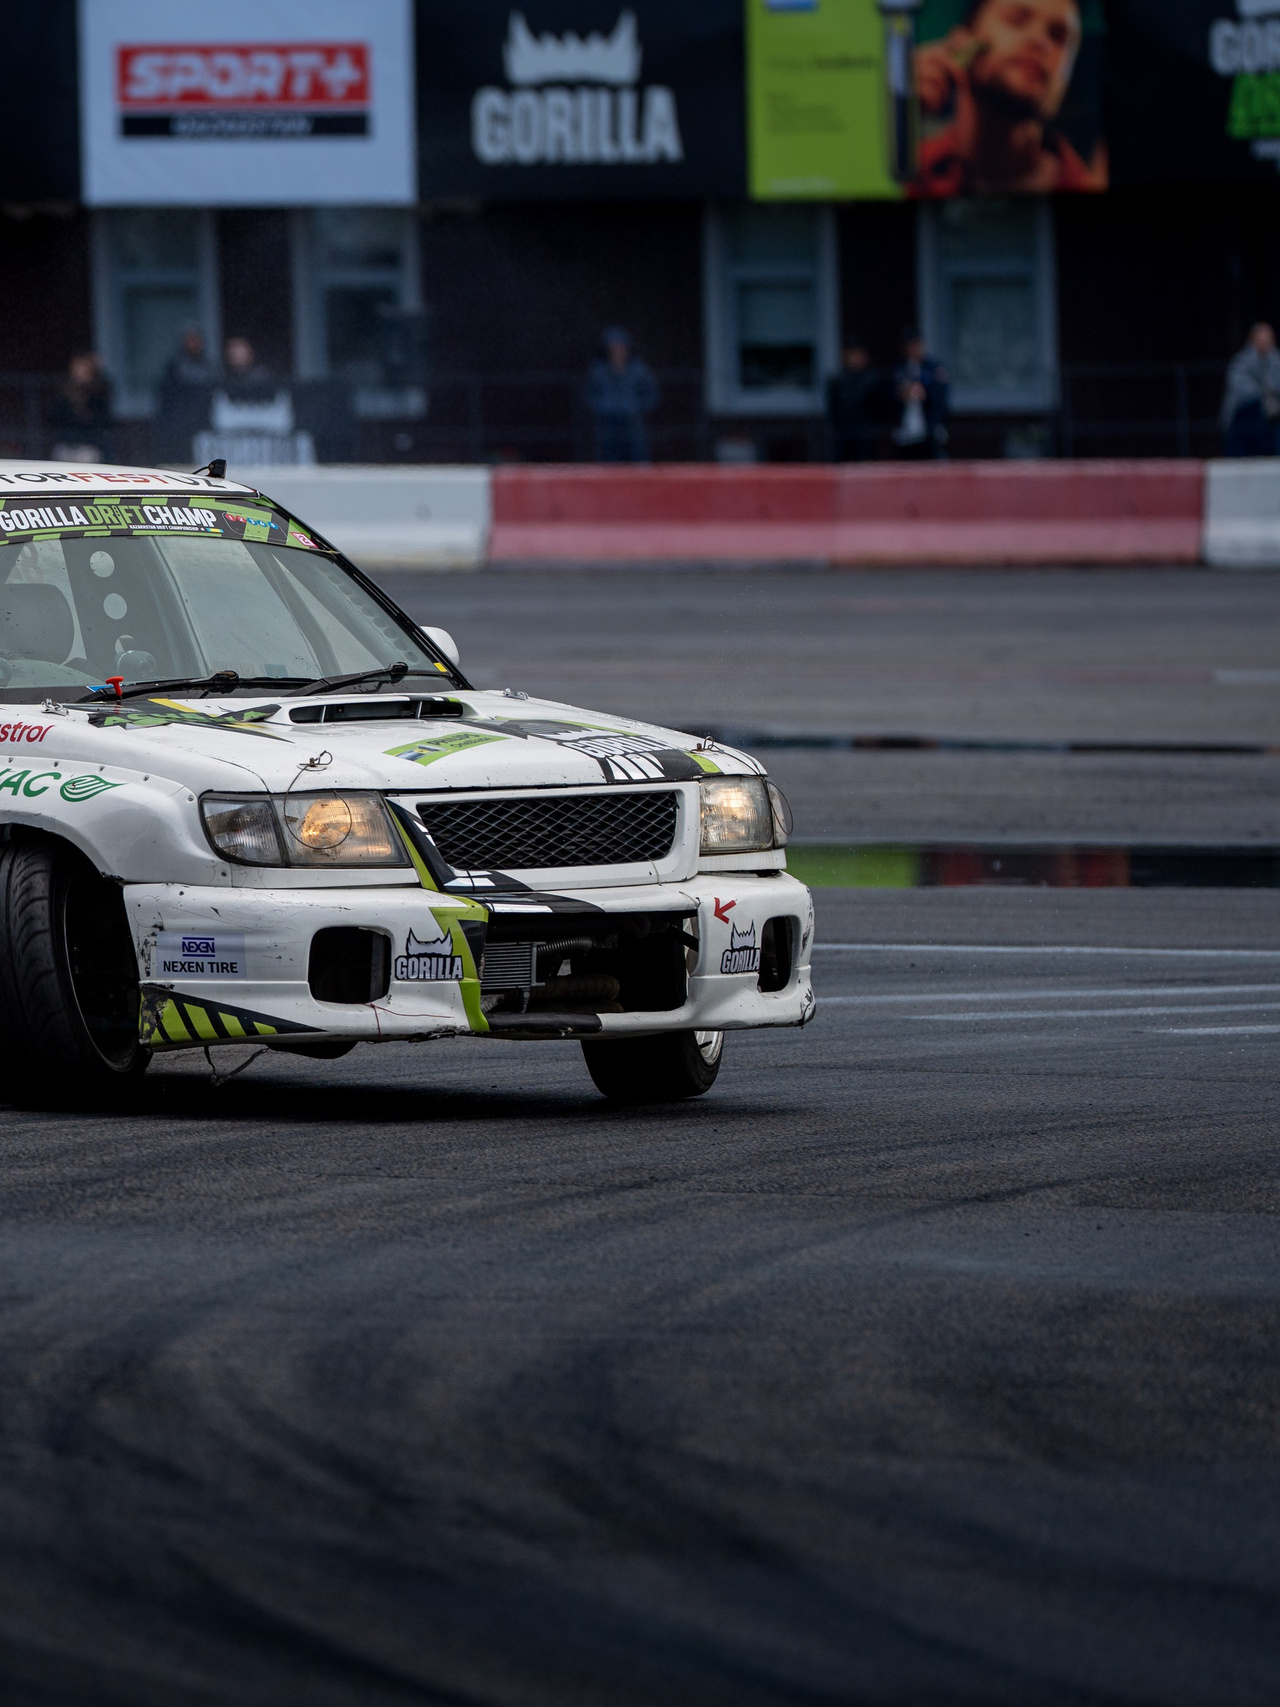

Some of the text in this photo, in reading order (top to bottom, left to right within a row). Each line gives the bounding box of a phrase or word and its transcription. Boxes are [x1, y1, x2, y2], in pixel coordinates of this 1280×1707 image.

[126, 50, 361, 99] SPORT+
[473, 87, 681, 163] GORILLA
[82, 505, 146, 527] DRIFT
[142, 505, 217, 527] CHAMP
[181, 941, 215, 953] NEXEN
[163, 961, 238, 973] NEXEN TIRE
[396, 956, 463, 979] GORILLA
[722, 950, 761, 973] GORILLA
